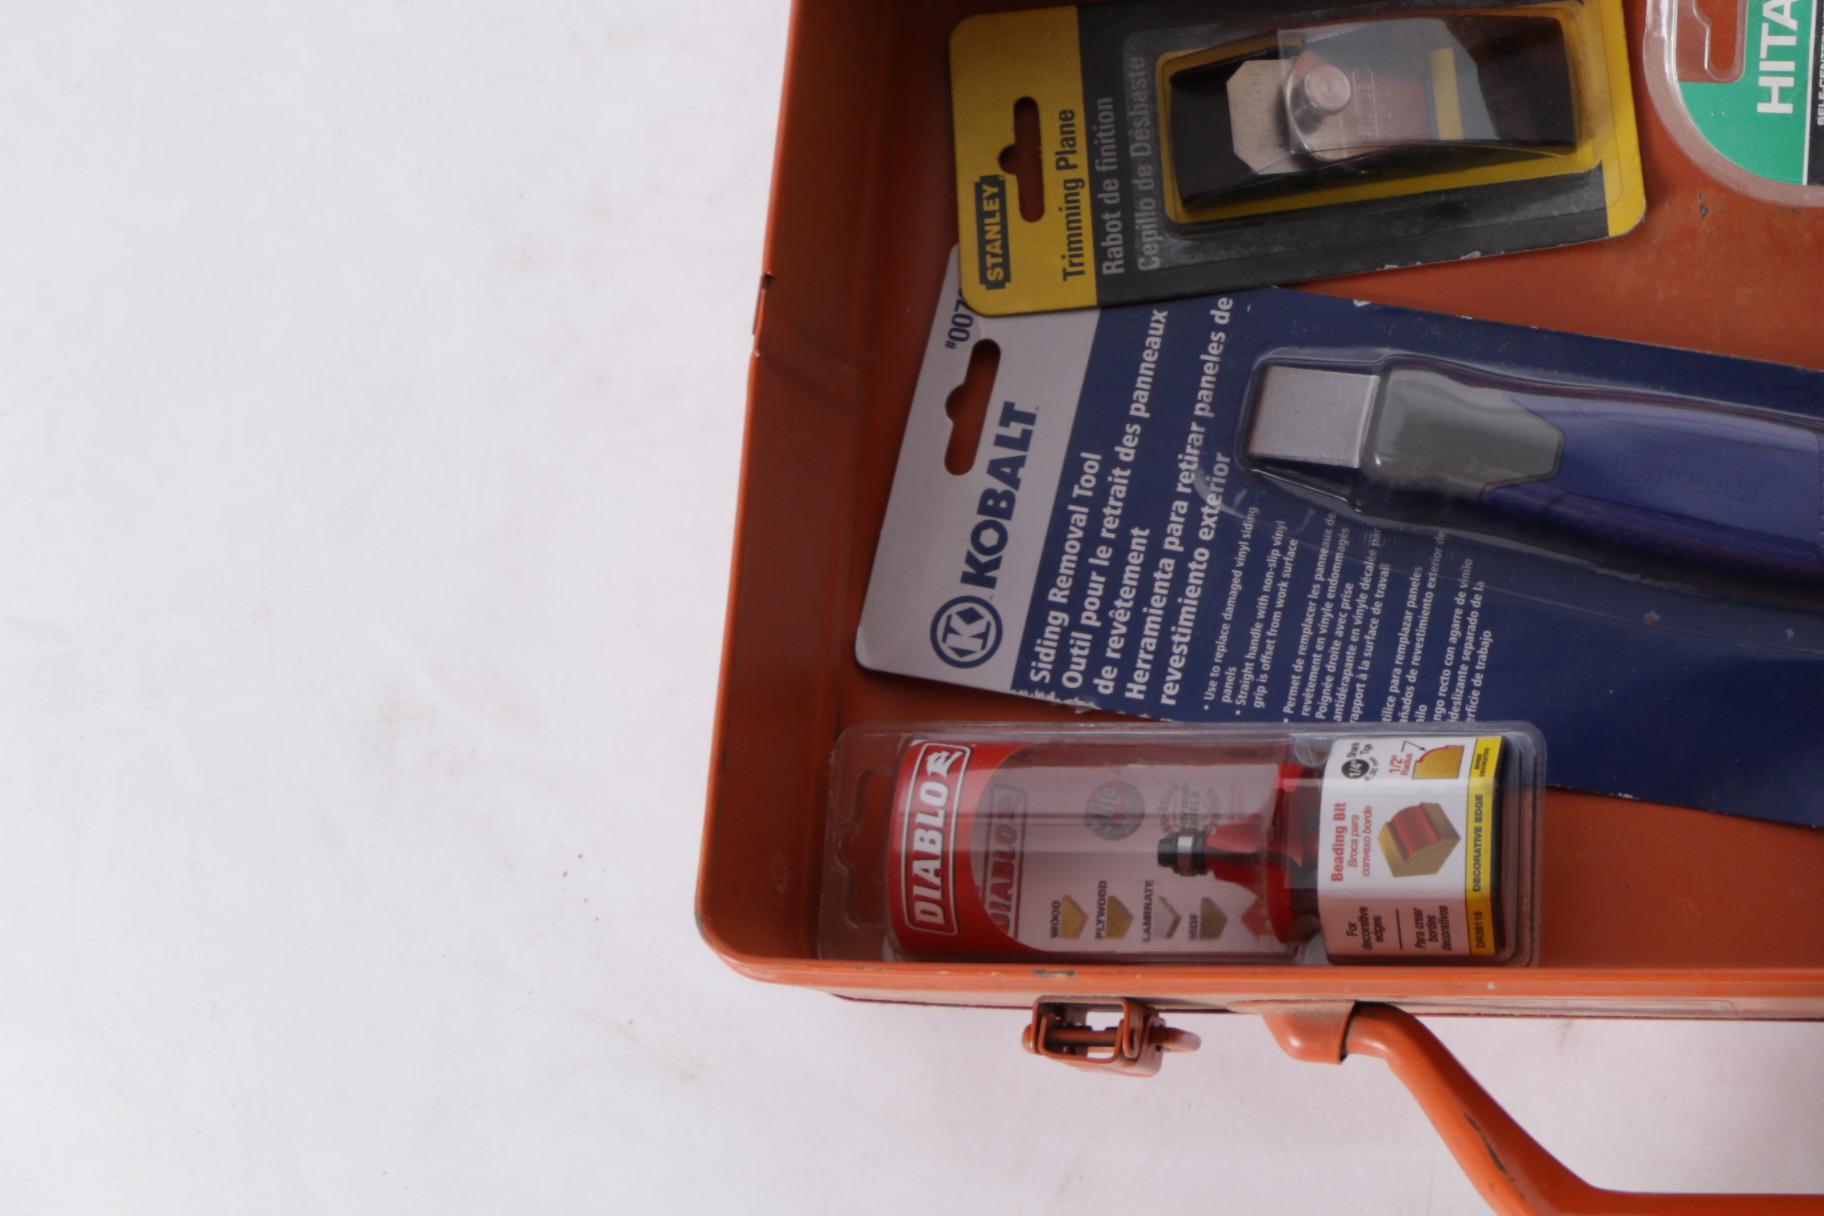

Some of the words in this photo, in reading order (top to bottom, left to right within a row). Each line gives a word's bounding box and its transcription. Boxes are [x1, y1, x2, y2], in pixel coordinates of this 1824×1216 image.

[1127, 57, 1151, 158] Desbaste
[1055, 109, 1079, 171] Plane
[1093, 97, 1118, 172] finition
[1097, 179, 1120, 204] de
[1131, 164, 1154, 190] de
[982, 184, 1004, 282] STANLEY
[1059, 178, 1085, 281] Trimming
[1101, 211, 1125, 275] Rabot
[1135, 198, 1164, 271] Cepillo
[1209, 297, 1233, 325] de
[1129, 309, 1168, 418] panneaux
[1194, 331, 1226, 418] paneles
[1114, 423, 1141, 462] des
[1176, 422, 1206, 494] retirar
[960, 401, 1038, 590] KOBALT
[1072, 451, 1102, 498] Tool
[1101, 466, 1132, 539] retrait
[1164, 499, 1189, 552] para
[1241, 506, 1260, 539] siding
[1048, 505, 1089, 604] Removal
[1088, 545, 1113, 566] le
[1235, 540, 1250, 568] vinyl
[1282, 538, 1298, 580] surface
[1314, 535, 1333, 582] panneaux
[1080, 571, 1107, 627] pour
[1160, 548, 1210, 706] revestimiento
[1199, 452, 1232, 541] exterior
[1221, 569, 1243, 622] damaged
[1274, 582, 1289, 609] work
[1307, 584, 1321, 600] les
[1093, 665, 1118, 695] de
[1106, 526, 1150, 659] revêtement
[1124, 557, 1176, 700] Herramienta
[1235, 660, 1255, 706] Straight
[1245, 622, 1263, 659] handle
[1255, 594, 1270, 621] with
[1263, 550, 1281, 593] non-slip
[1272, 520, 1287, 548] vinyl
[1267, 610, 1282, 637] from
[1298, 601, 1317, 656] remplacer
[1030, 610, 1070, 684] Siding
[1062, 632, 1093, 689] Outil
[1214, 623, 1230, 663] replace
[1260, 638, 1277, 670] offset
[1292, 657, 1304, 673] de
[1204, 677, 1216, 702] Use
[1209, 665, 1220, 675] to
[1221, 666, 1237, 704] panels
[1261, 673, 1269, 684] is
[1253, 684, 1267, 709] grip
[1283, 674, 1300, 714] Permet
[1334, 802, 1346, 822] Bit
[1350, 814, 1361, 838] para
[1363, 806, 1373, 834] borde
[1473, 794, 1484, 823] EDGE
[912, 780, 949, 925] DIABLO
[1331, 825, 1347, 882] Beading
[1348, 839, 1359, 868] Broca
[1473, 827, 1483, 892] DECORATIVE
[1050, 900, 1062, 938] WOOD
[1095, 880, 1108, 940] PLYWOOD
[1142, 880, 1154, 942] LAMINATE
[1346, 921, 1357, 938] For
[1359, 906, 1374, 952] decorative
[1373, 916, 1386, 943] edges
[1413, 907, 1424, 928] crear
[1426, 915, 1440, 943] bordes
[1440, 905, 1453, 952] decorativos
[1414, 929, 1427, 949] Para
